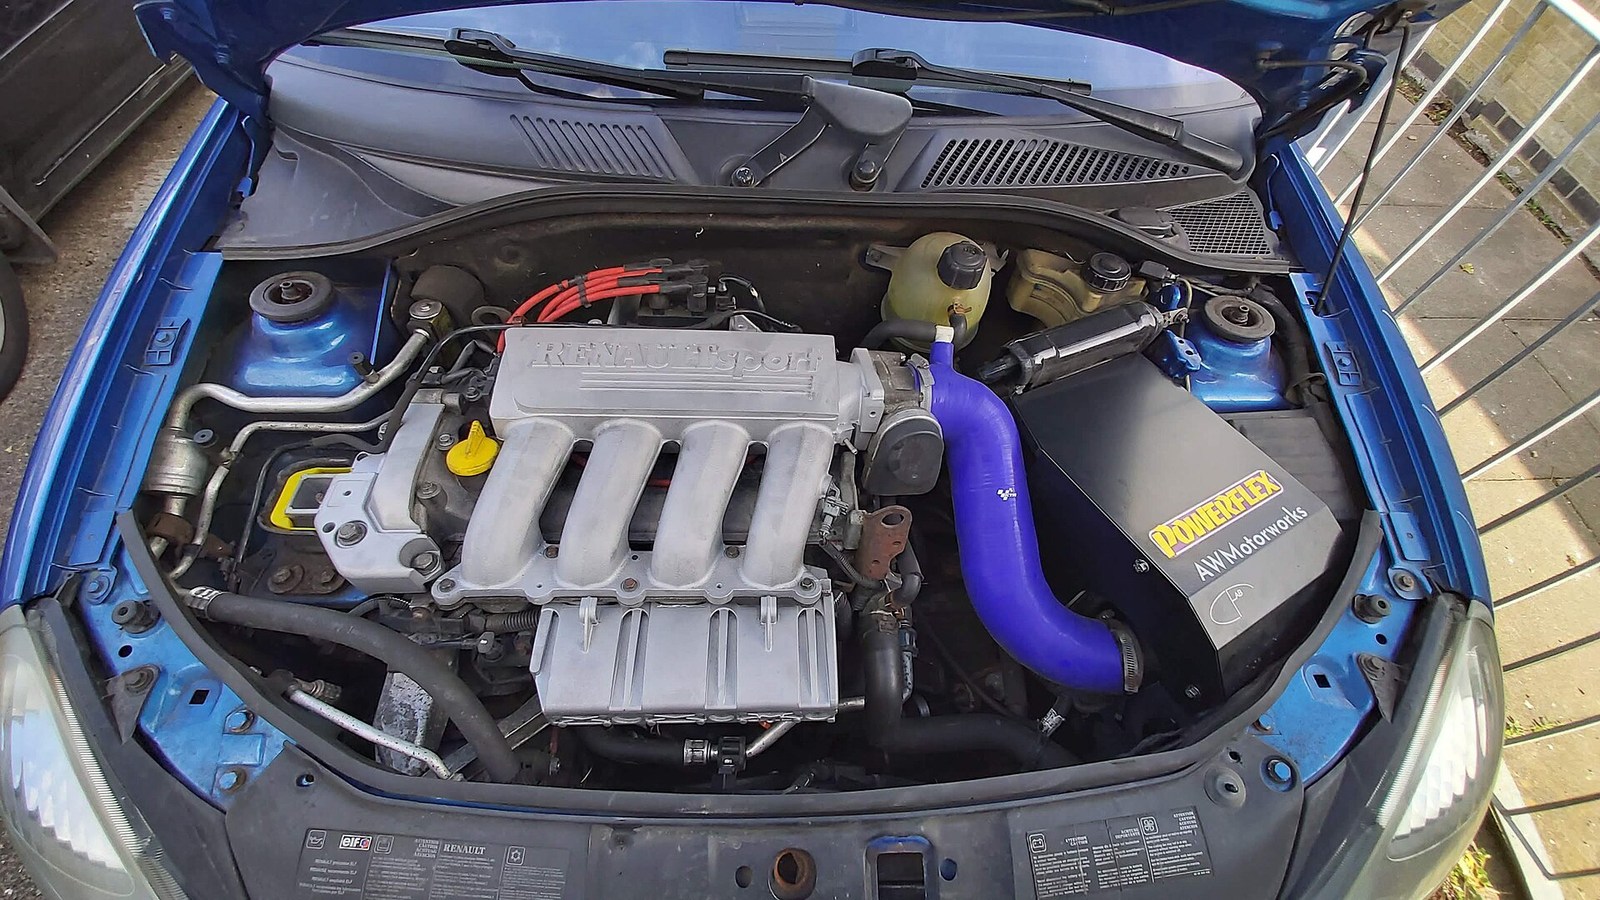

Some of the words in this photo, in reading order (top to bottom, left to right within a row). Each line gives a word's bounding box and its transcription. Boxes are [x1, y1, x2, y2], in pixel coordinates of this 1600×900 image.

[1151, 470, 1280, 559] POWERFLEX
[1194, 506, 1309, 582] AWMotorworks
[342, 837, 361, 847] elf
[443, 843, 486, 855] RENAULT
